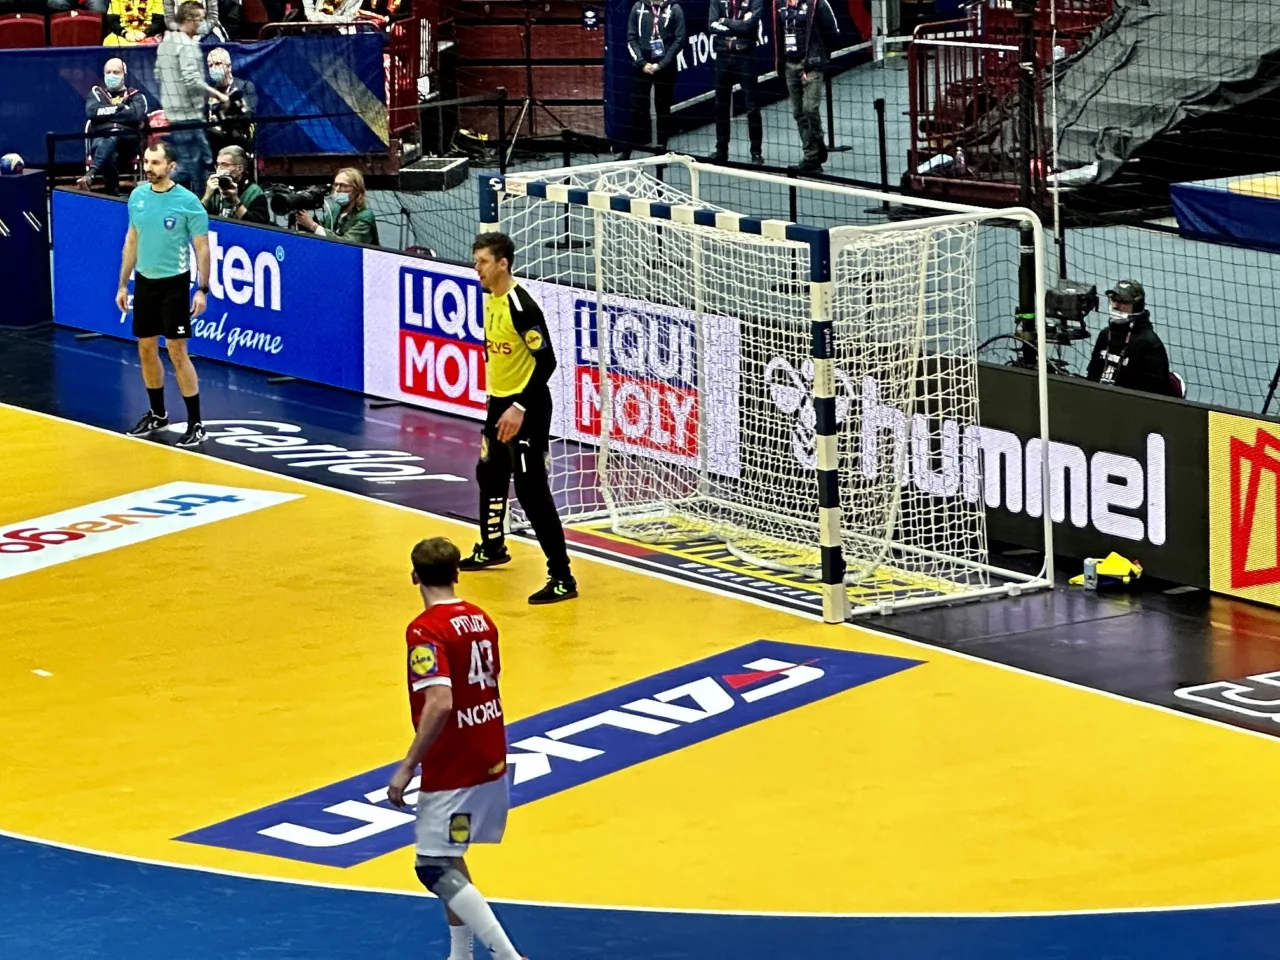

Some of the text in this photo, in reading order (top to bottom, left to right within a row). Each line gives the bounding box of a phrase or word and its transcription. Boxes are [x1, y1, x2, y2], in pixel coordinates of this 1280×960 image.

[404, 272, 486, 340] LIQU
[227, 324, 284, 357] game
[405, 337, 488, 405] MOL
[861, 375, 1167, 546] hummel
